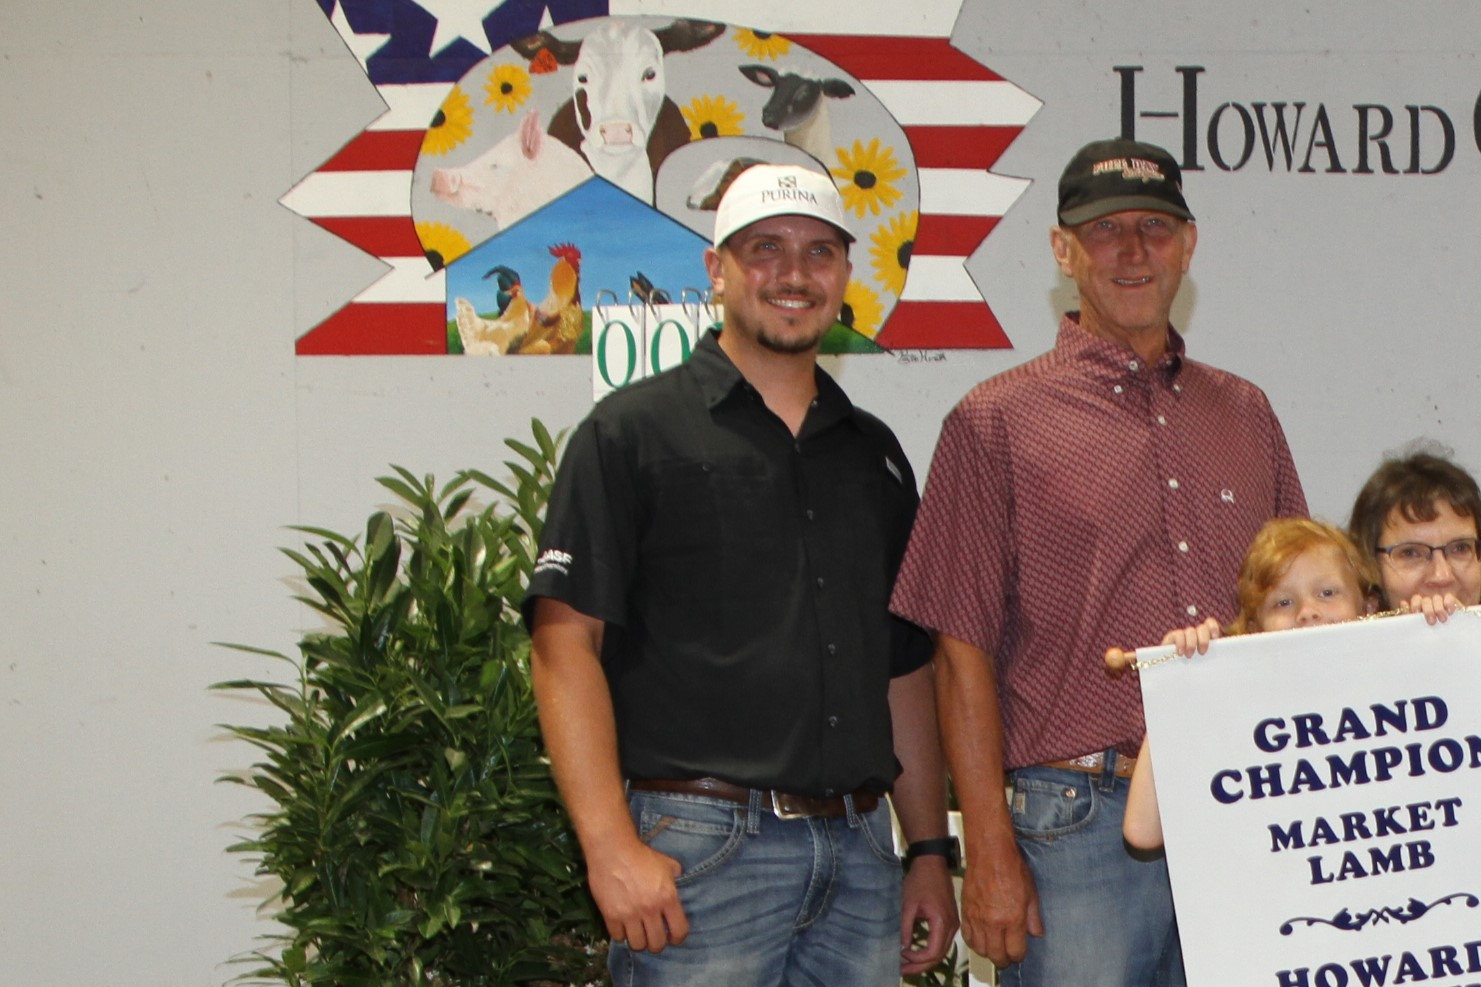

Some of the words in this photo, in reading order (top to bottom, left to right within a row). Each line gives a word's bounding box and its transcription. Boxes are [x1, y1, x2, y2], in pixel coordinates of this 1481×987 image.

[1113, 66, 1455, 174] HOWARD
[762, 190, 817, 204] PURINA
[1253, 696, 1448, 752] GRAND
[1267, 797, 1462, 852] MARKET
[1307, 840, 1435, 885] LAMB
